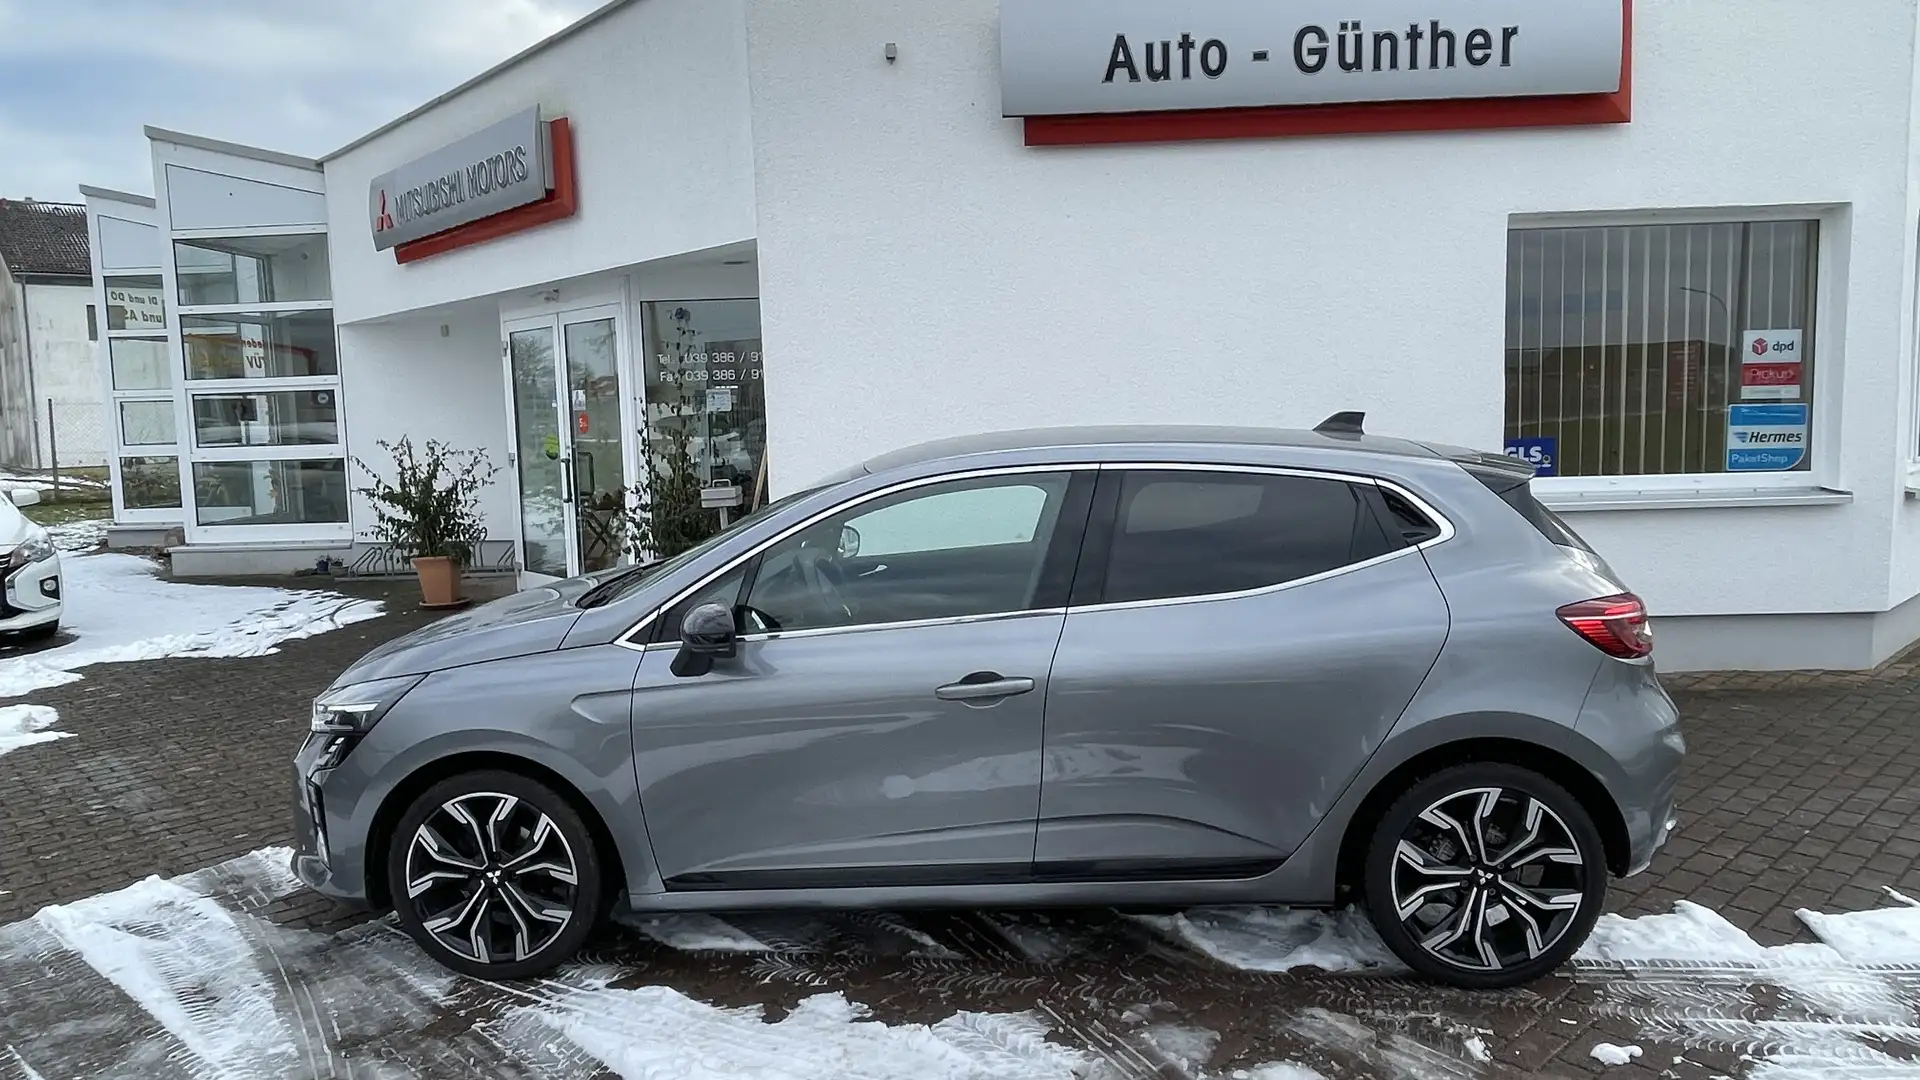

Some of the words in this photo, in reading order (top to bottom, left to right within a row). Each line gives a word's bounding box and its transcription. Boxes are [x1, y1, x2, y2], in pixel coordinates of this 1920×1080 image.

[1101, 32, 1228, 83] Auto
[1293, 18, 1519, 75] Günther
[394, 170, 465, 224] MITSUBISHI
[466, 144, 528, 199] MOTORS
[1772, 340, 1795, 353] dpd
[712, 352, 735, 363] 386
[685, 370, 709, 381] 039
[712, 369, 736, 380] 386
[1748, 431, 1803, 443] Hermes
